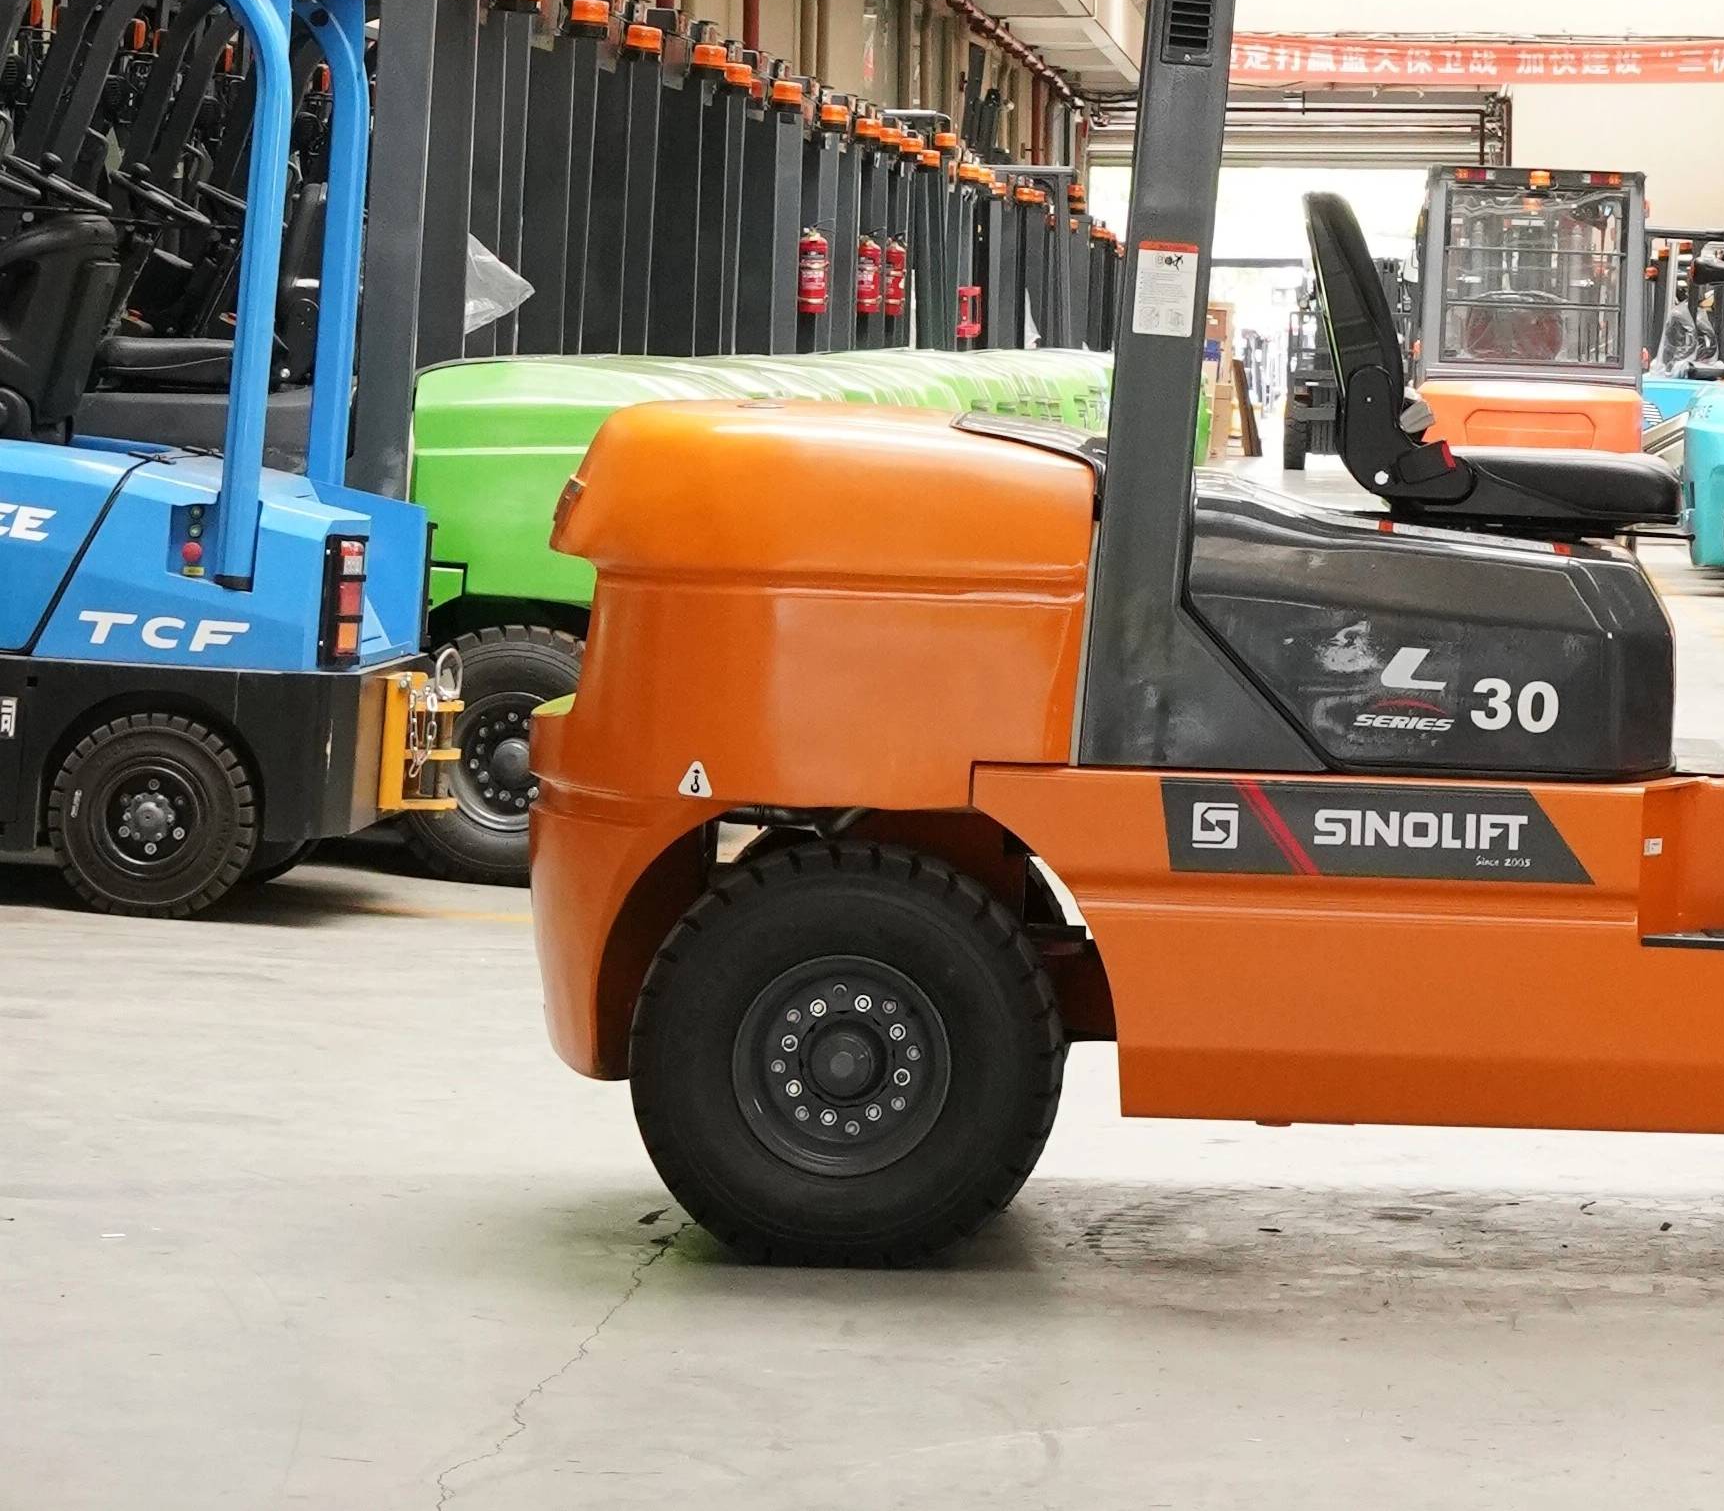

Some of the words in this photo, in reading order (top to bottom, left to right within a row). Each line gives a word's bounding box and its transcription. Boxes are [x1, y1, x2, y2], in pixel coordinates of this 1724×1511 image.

[1516, 51, 1643, 76] 加快建设
[79, 610, 250, 652] TCF
[1381, 647, 1447, 690] L
[1353, 714, 1455, 731] SERIES
[1470, 677, 1559, 733] 30
[1313, 809, 1529, 850] SINOLIFT
[1475, 855, 1499, 866] Since
[1504, 857, 1532, 867] 2005
